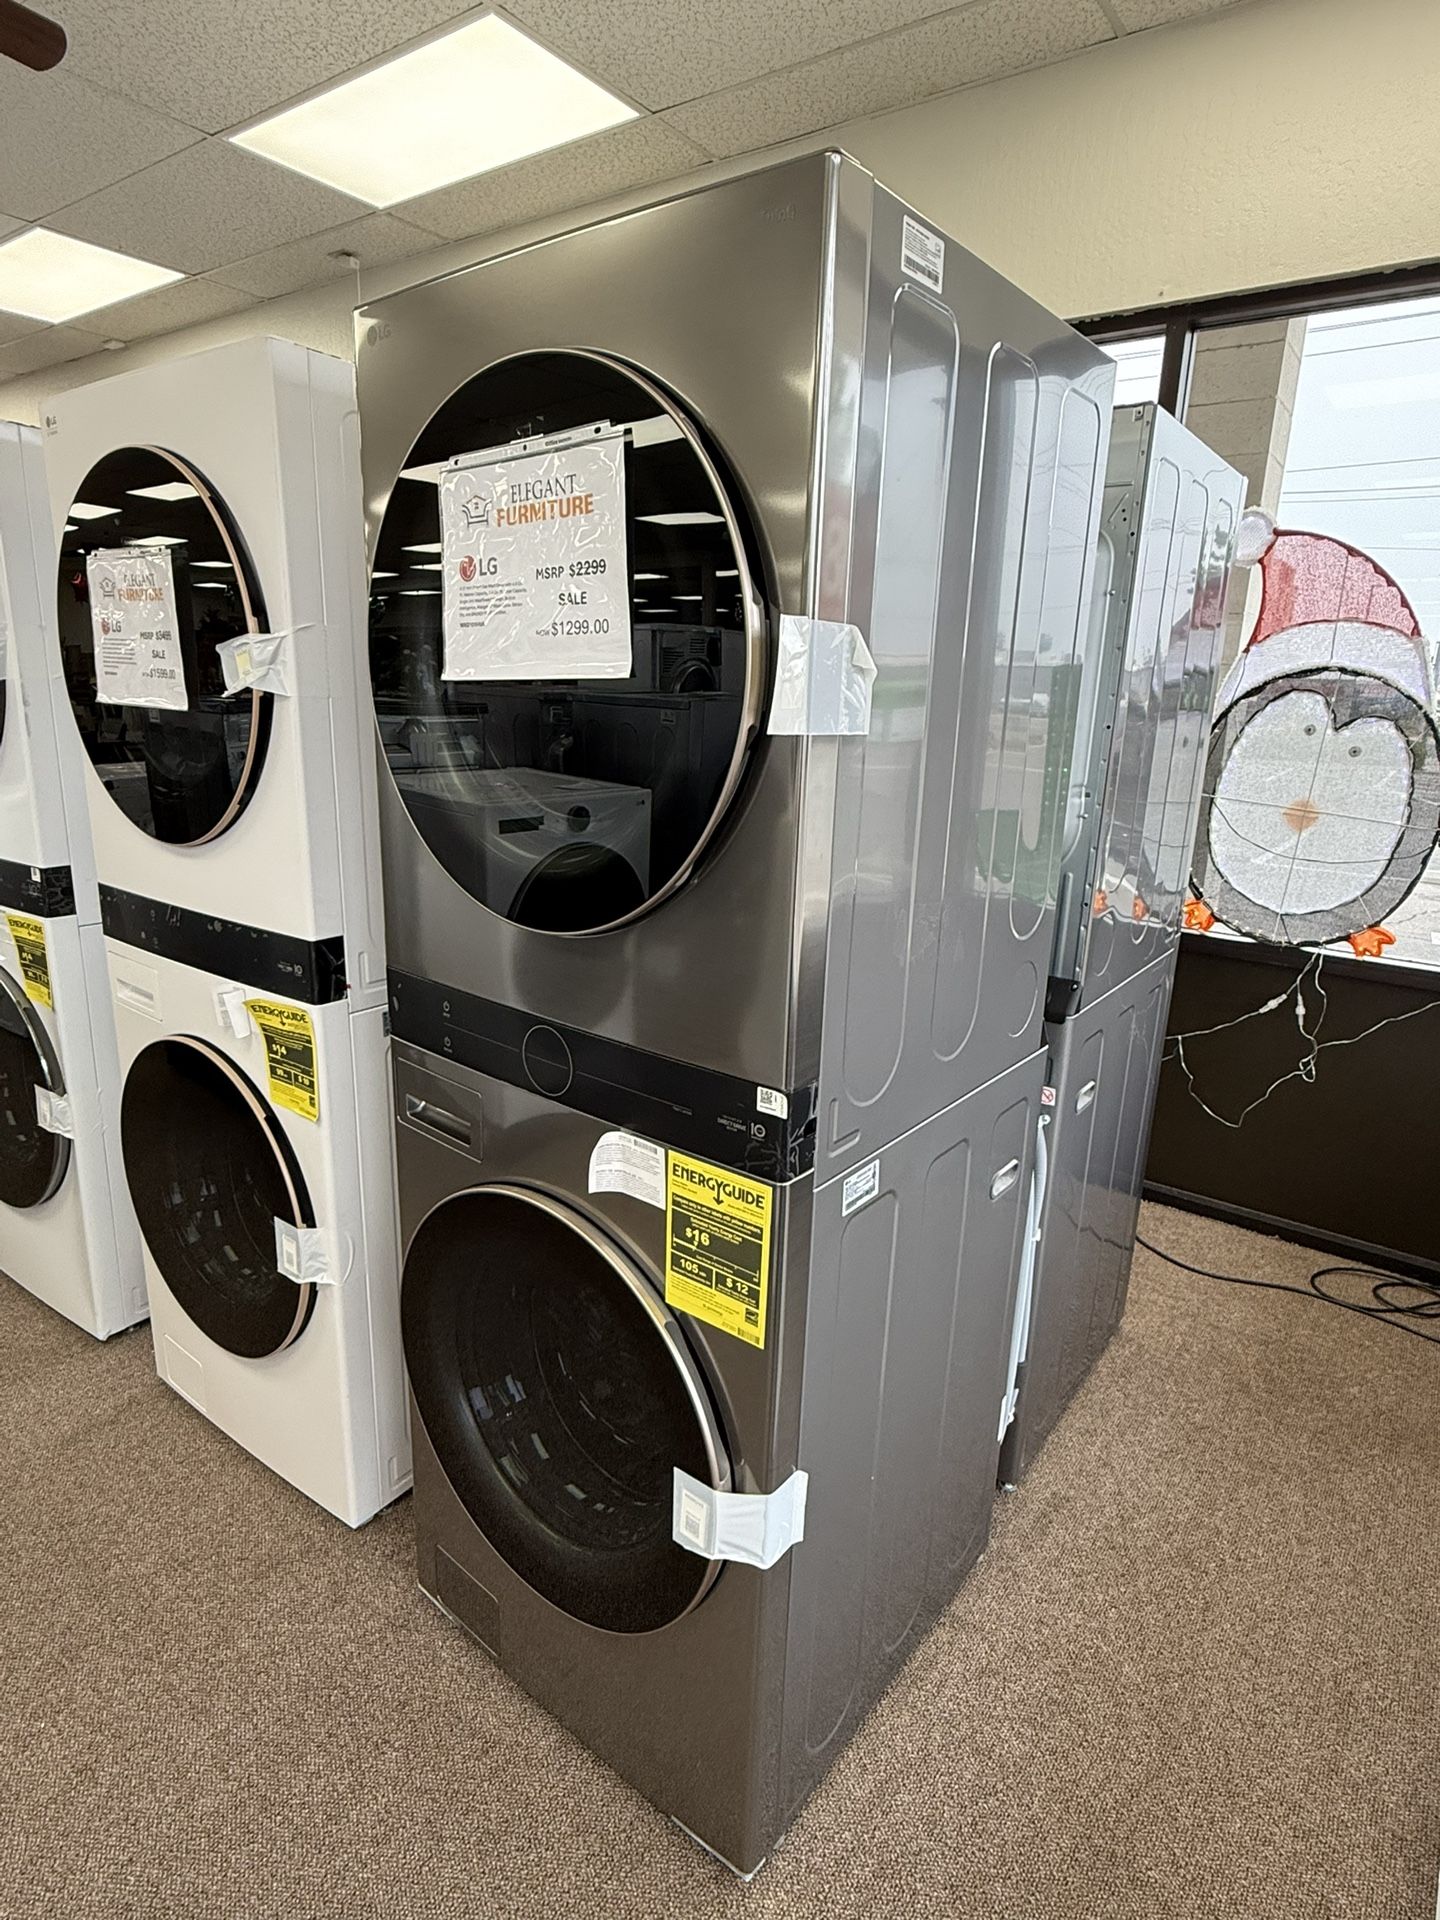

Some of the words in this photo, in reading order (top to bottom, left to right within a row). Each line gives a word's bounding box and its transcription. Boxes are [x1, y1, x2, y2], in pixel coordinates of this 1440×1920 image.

[511, 474, 577, 503] ELEGANT
[497, 493, 594, 527] FURNITURE
[479, 557, 498, 576] LG
[536, 566, 564, 580] MSRP
[569, 558, 606, 578] $2299
[558, 591, 587, 606] SALE
[112, 620, 121, 632] LG
[551, 618, 609, 637] $1299.00
[152, 649, 165, 659] SALE
[673, 1164, 765, 1210] ENERGYGUIDE
[685, 1227, 710, 1246] $16
[679, 1258, 699, 1274] 105
